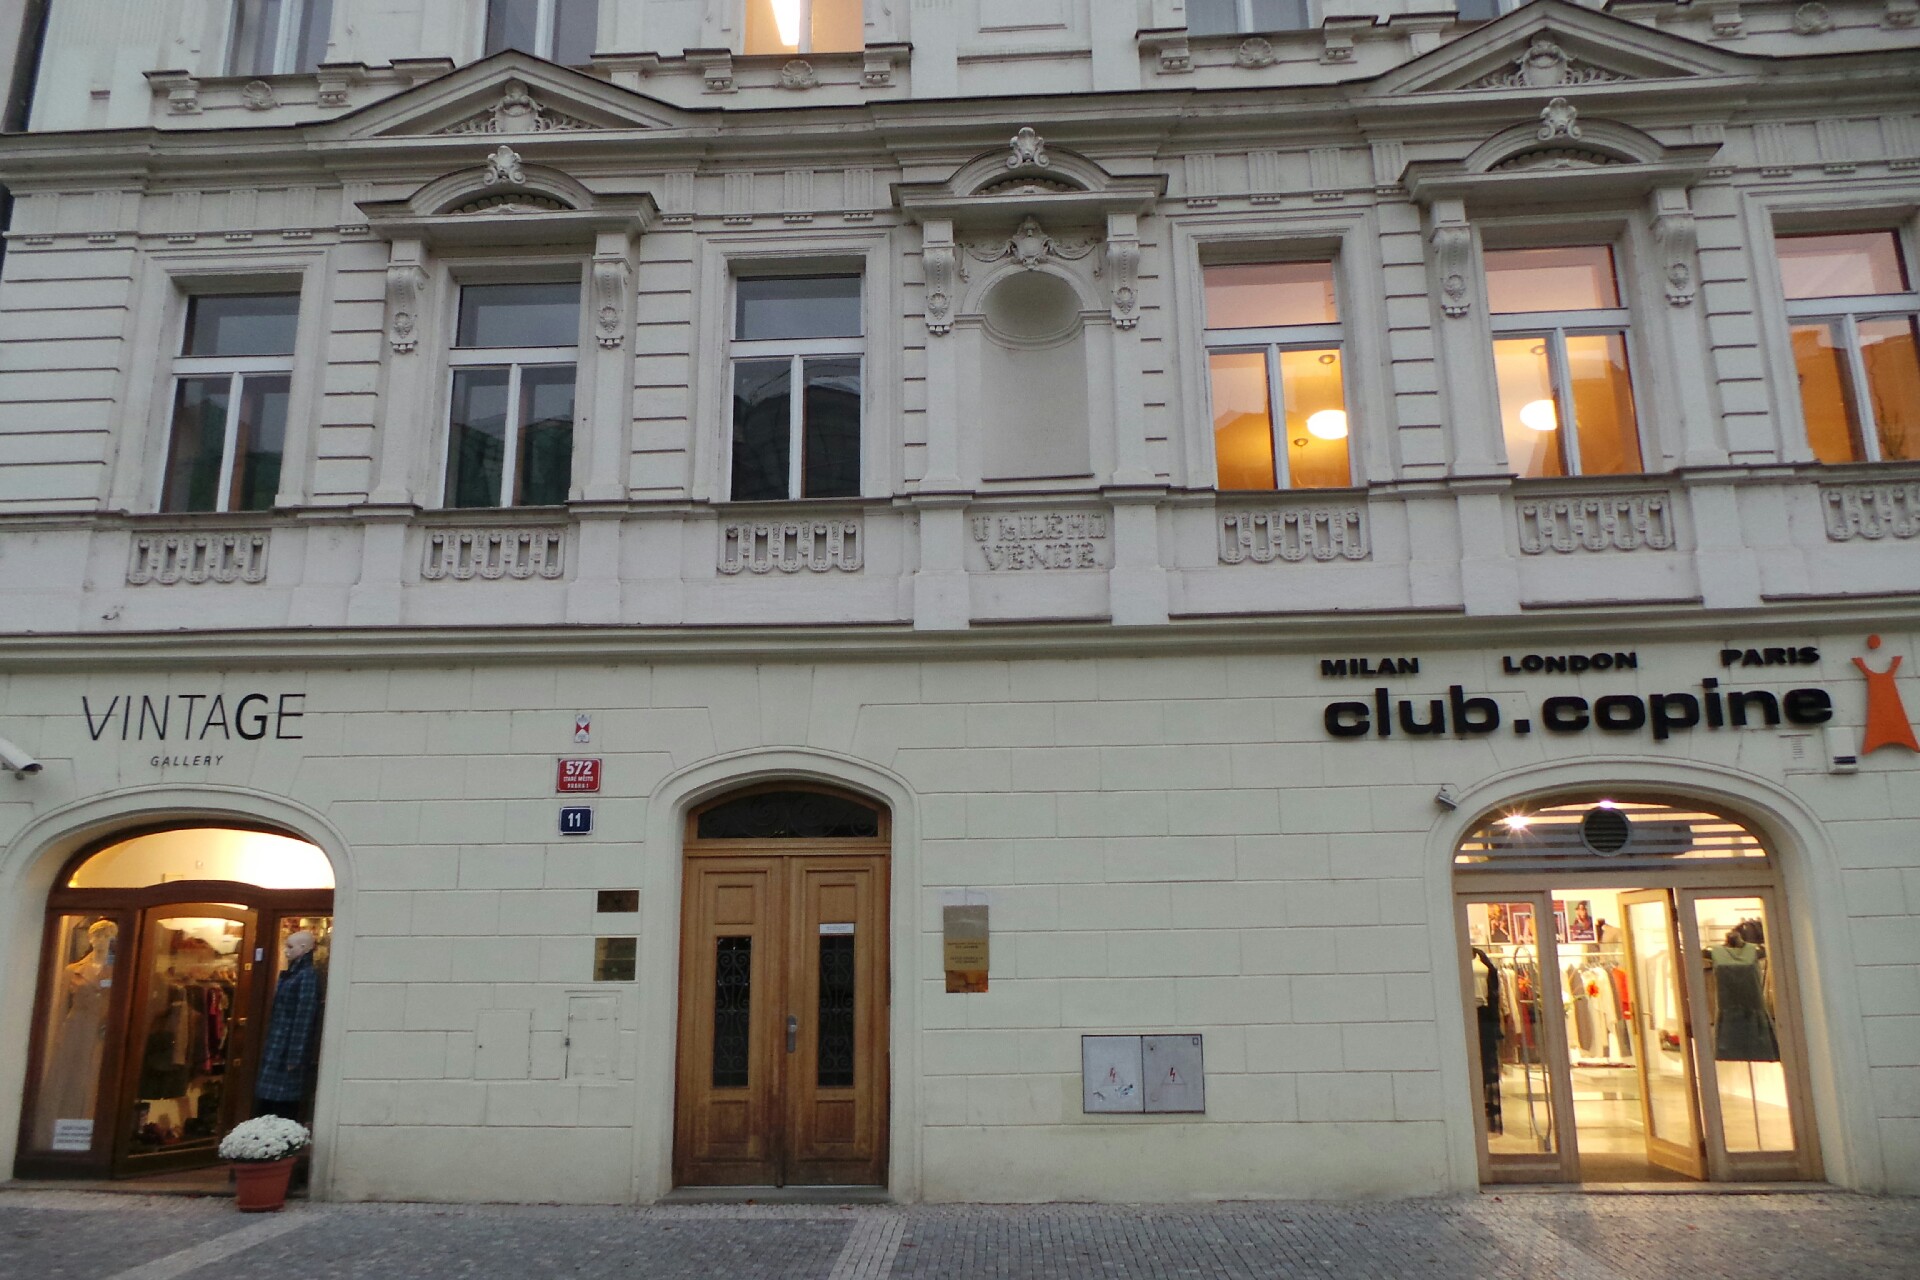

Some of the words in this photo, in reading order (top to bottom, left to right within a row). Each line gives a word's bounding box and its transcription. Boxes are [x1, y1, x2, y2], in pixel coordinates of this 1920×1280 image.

[971, 516, 990, 542] U
[1320, 657, 1420, 677] MILAN
[1502, 652, 1638, 674] LONDON
[1720, 646, 1821, 668] PARIS
[82, 693, 307, 741] VINTAGE
[150, 755, 224, 768] GALLERY
[566, 760, 593, 776] 572
[567, 812, 582, 828] 11
